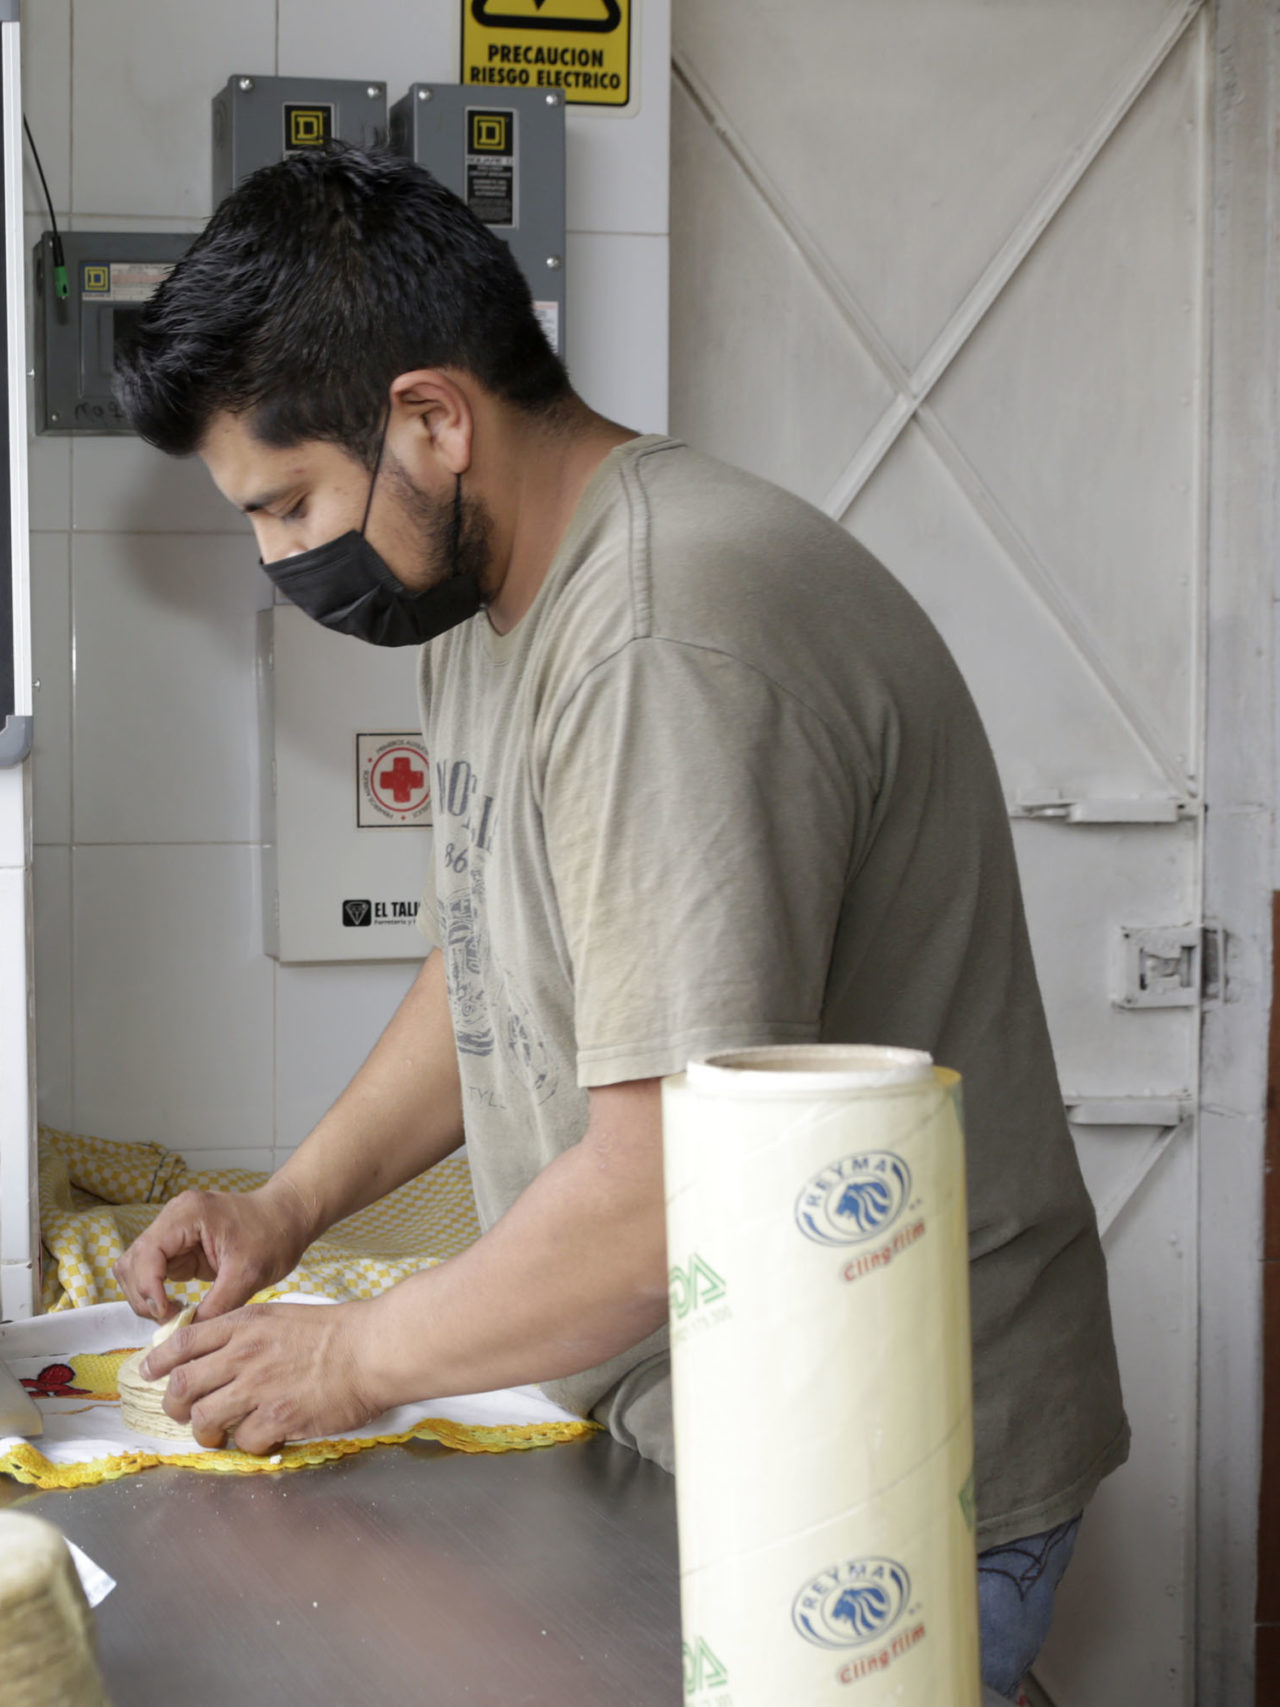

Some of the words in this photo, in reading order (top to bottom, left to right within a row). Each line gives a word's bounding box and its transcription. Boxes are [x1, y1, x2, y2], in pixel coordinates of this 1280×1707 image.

[488, 44, 604, 67] PRECAUCION
[470, 66, 530, 84] RIESGO
[537, 69, 622, 89] ELECTRICO
[374, 901, 387, 917] EL
[806, 1157, 887, 1207] REYMA
[802, 1563, 884, 1610] REYMA
